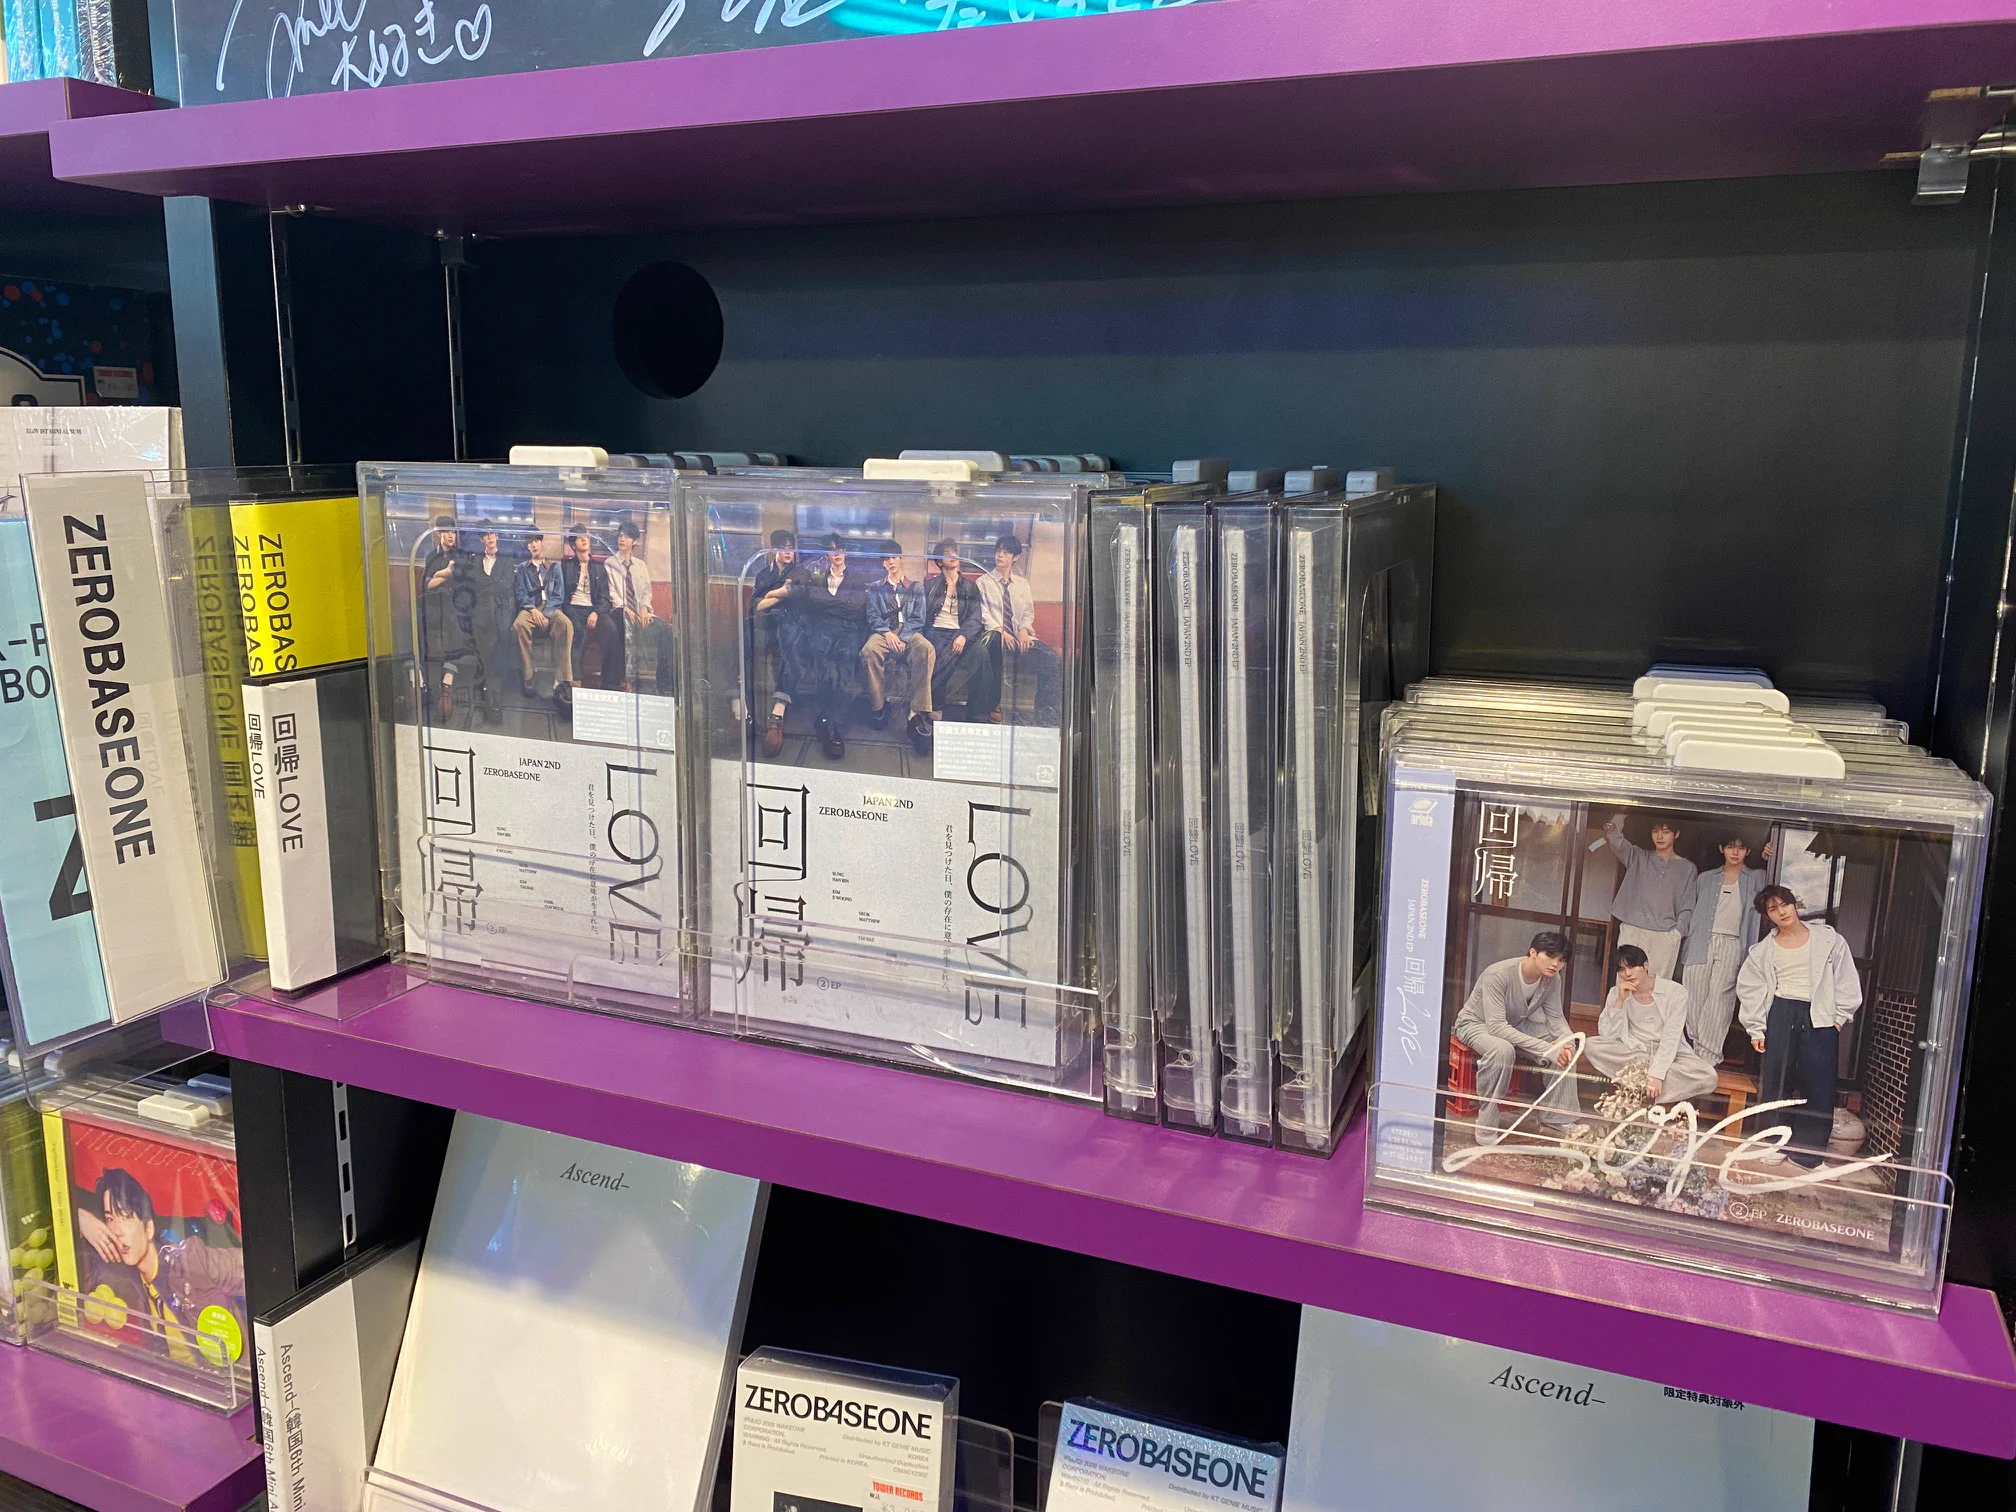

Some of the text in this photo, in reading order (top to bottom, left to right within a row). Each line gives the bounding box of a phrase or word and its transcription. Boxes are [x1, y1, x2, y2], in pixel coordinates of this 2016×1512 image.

[63, 514, 156, 865] ZEROBASEONE
[519, 757, 561, 770] JAPAN 2ND
[272, 713, 304, 853] 回帰LOVE
[483, 767, 541, 782] ZEROBASEONE
[862, 795, 914, 810] JAPAN 2ND
[818, 806, 888, 822] ZEROBASEONE
[1474, 801, 1521, 900] 回帰
[1418, 878, 1429, 939] ZEROBASEONE
[1776, 1213, 1875, 1240] ZEROBASEONE
[1664, 1386, 1746, 1411] 限定特典対象外
[782, 1439, 799, 1448] Rights
[843, 1434, 873, 1445] Distributed
[891, 1442, 909, 1451] GENIE
[911, 1445, 931, 1454] MUSIC
[819, 1454, 839, 1463] Printed
[859, 1453, 929, 1471] Unauthorized Duplication
[908, 1453, 929, 1462] KOREA
[873, 1481, 923, 1501] TOWER RECORDS
[1168, 1483, 1201, 1497] Distributed
[1220, 1497, 1241, 1509] GENIE
